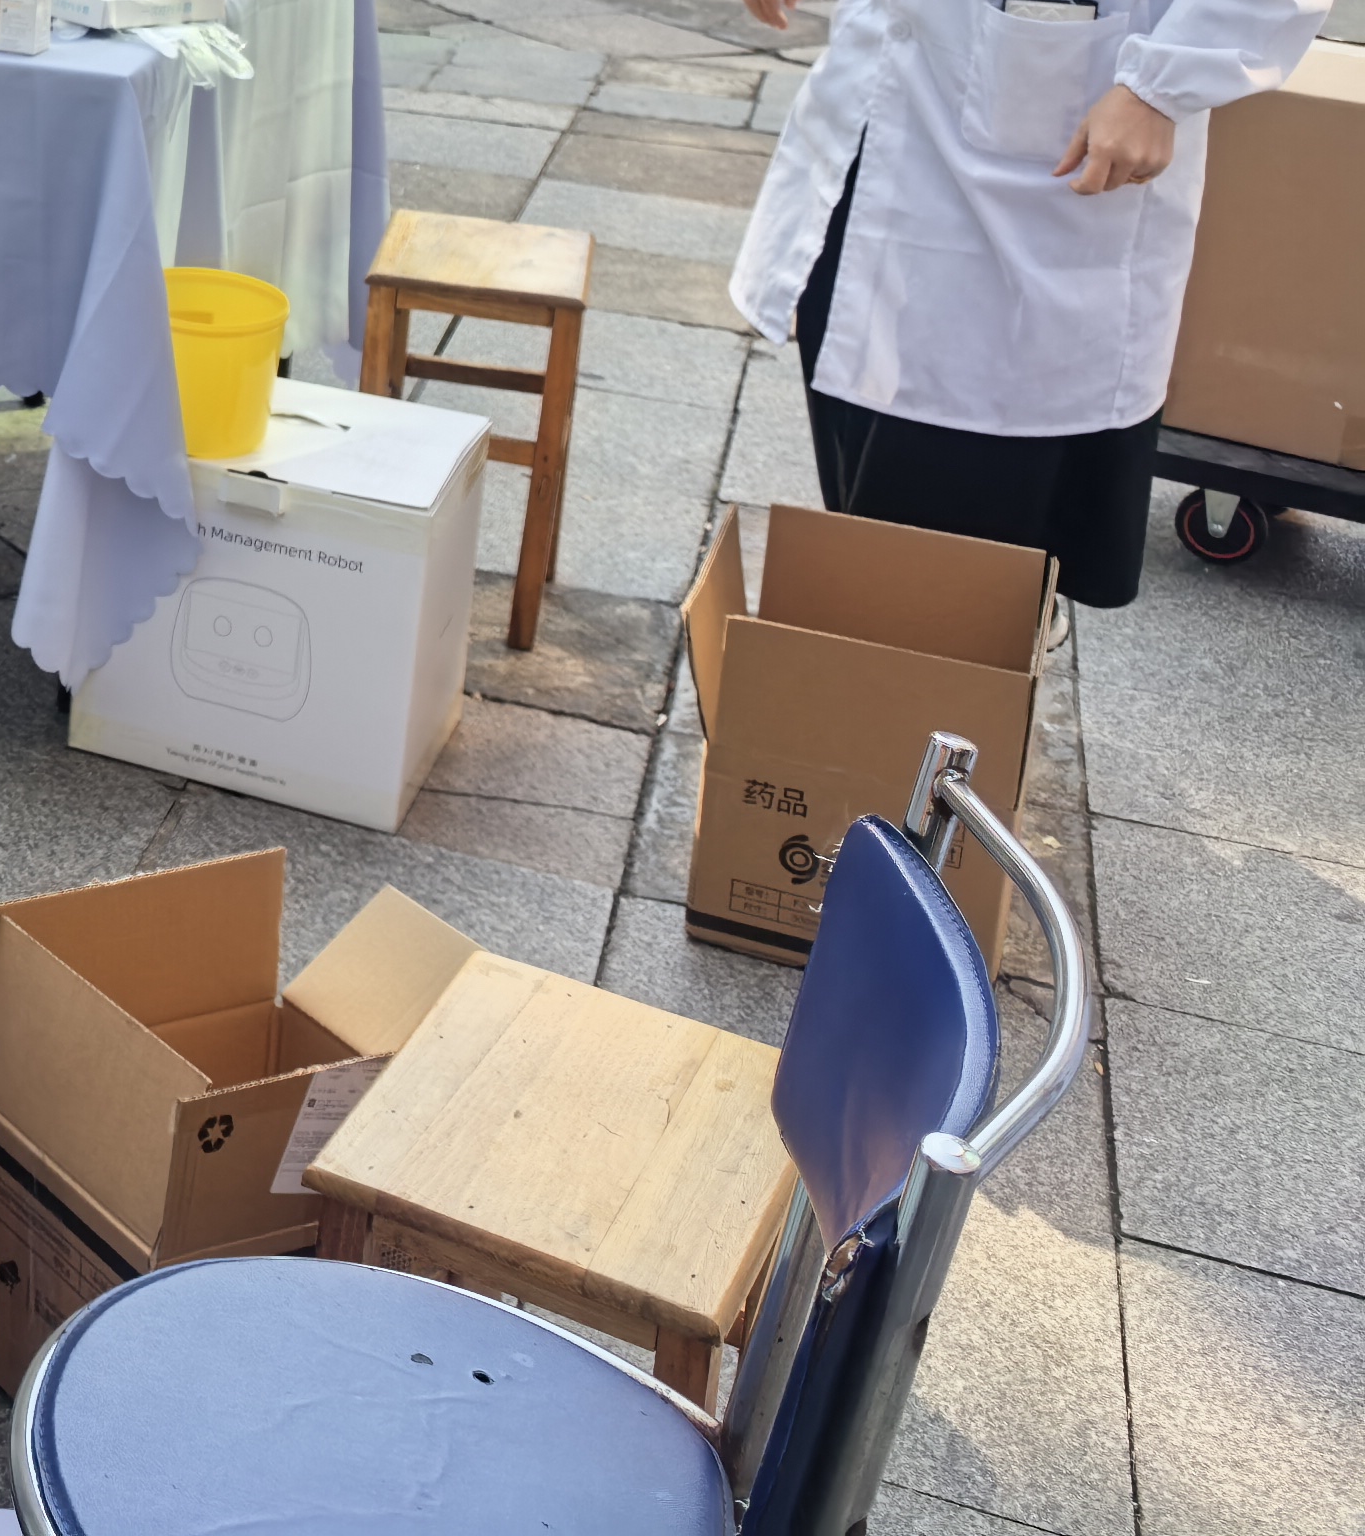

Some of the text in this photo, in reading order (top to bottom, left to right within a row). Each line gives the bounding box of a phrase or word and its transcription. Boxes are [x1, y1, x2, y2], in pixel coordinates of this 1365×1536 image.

[211, 525, 313, 562] Management
[317, 550, 364, 574] Robot
[742, 779, 809, 818] 药品
